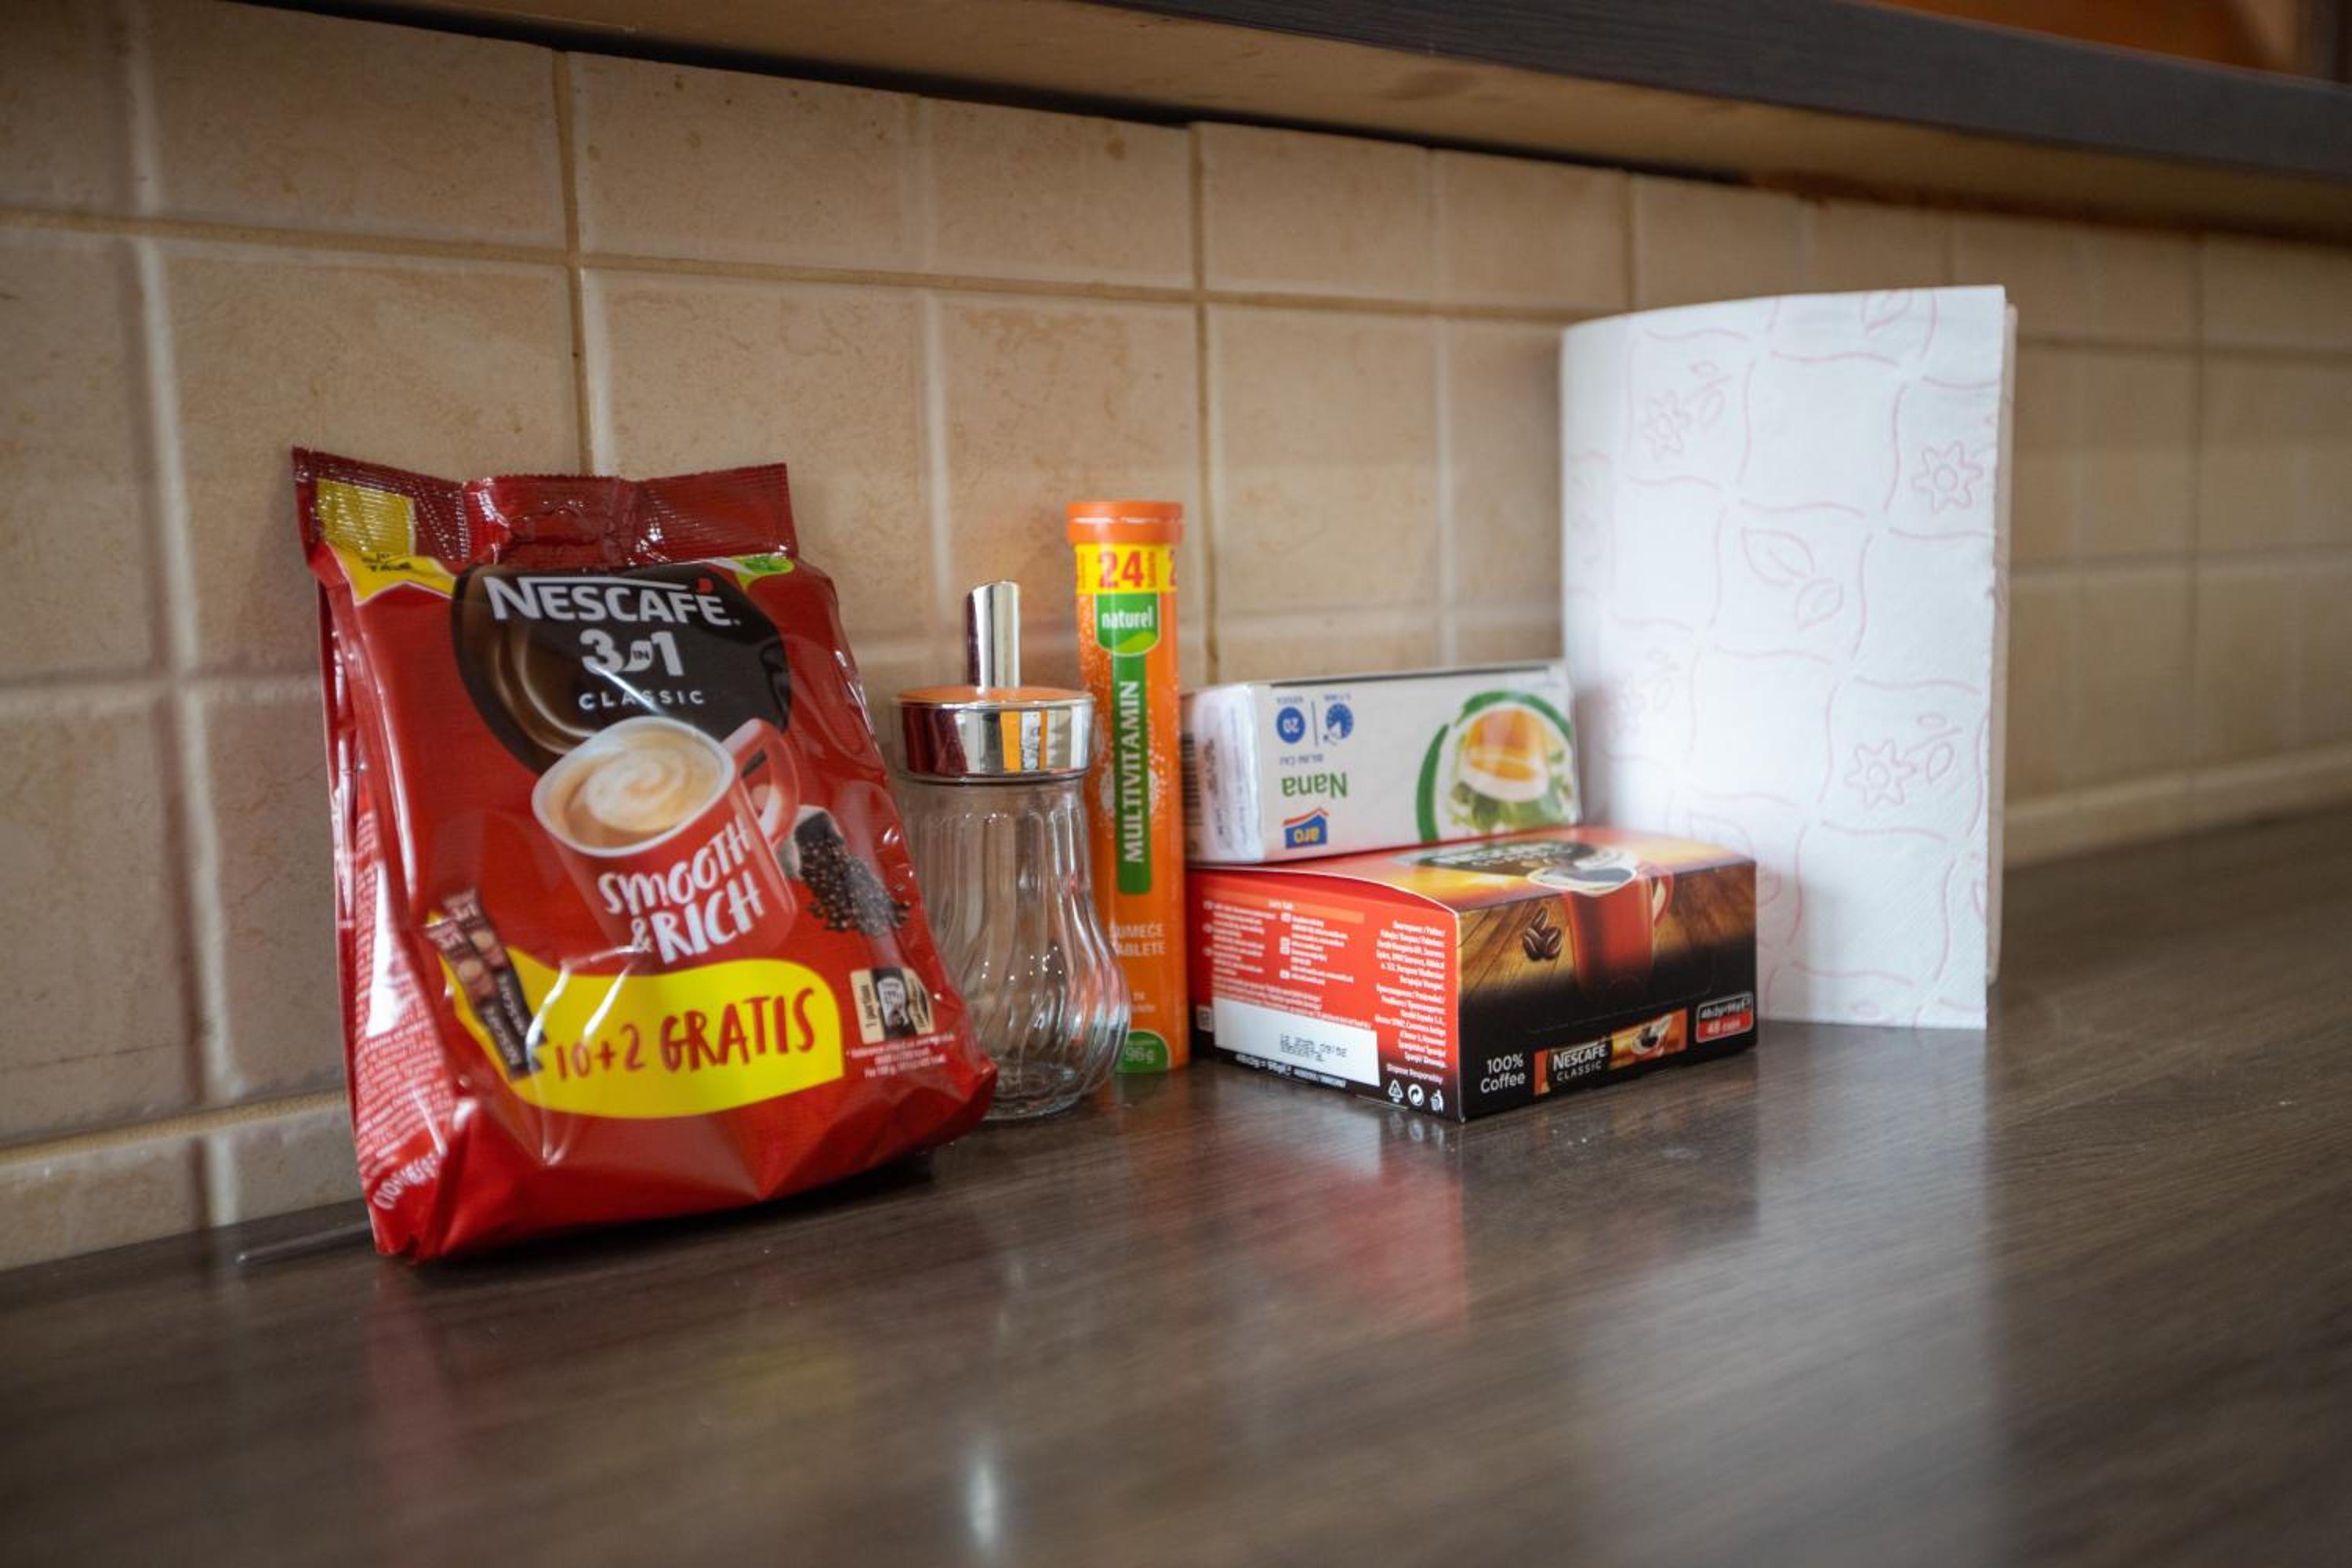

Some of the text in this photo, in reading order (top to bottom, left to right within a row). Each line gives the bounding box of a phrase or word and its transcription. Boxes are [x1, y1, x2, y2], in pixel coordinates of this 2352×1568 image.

[1098, 550, 1144, 588] 24
[1101, 604, 1155, 629] naturel
[579, 690, 705, 710] CLASSIC
[1120, 679, 1145, 864] MULTIVITAMIN
[1281, 771, 1348, 799] Nana
[1293, 826, 1320, 842] aro
[597, 814, 750, 916] SMOOTH
[650, 869, 765, 965] RICH
[555, 1023, 647, 1081] 10+2
[659, 986, 816, 1074] GRATIS
[1486, 1053, 1524, 1075] 100%
[1556, 1060, 1602, 1082] CLASSIC
[1480, 1072, 1526, 1094] Coffee
